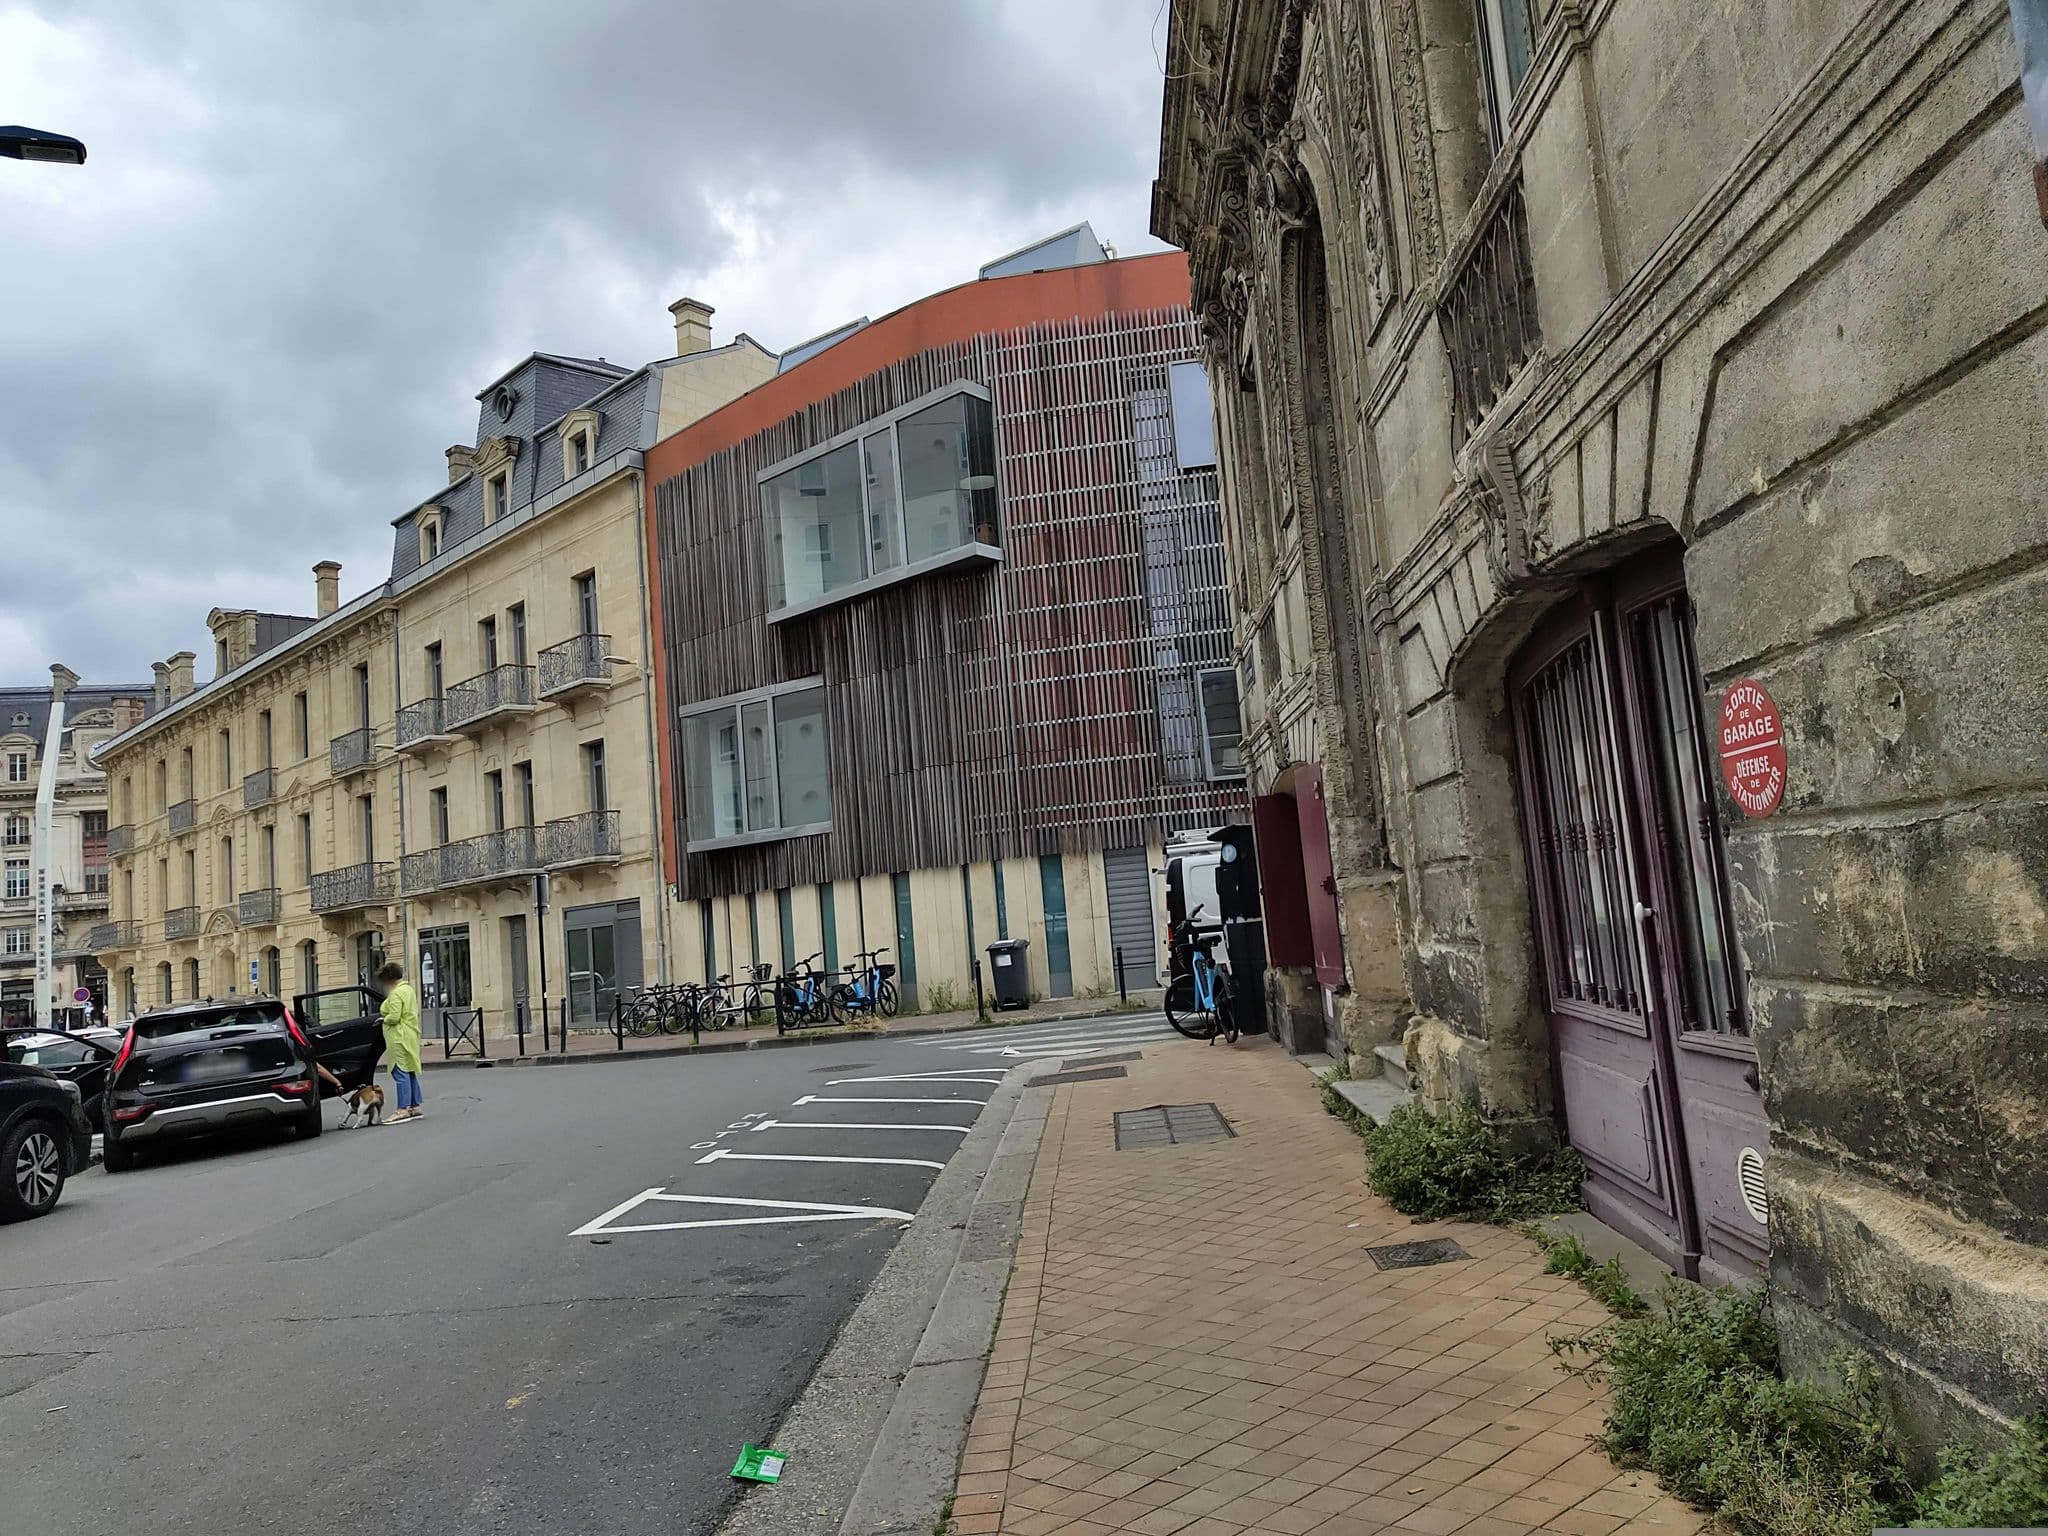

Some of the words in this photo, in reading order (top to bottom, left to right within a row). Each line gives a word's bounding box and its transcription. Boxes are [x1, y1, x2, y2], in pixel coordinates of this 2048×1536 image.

[1725, 687, 1764, 721] SORTIE
[1740, 708, 1750, 719] DE
[1723, 715, 1774, 745] GARAGE
[1736, 755, 1770, 778] DÉFENSE
[1731, 766, 1782, 810] STATIONNER
[1750, 778, 1761, 789] DE
[689, 1112, 768, 1149] MOTO
